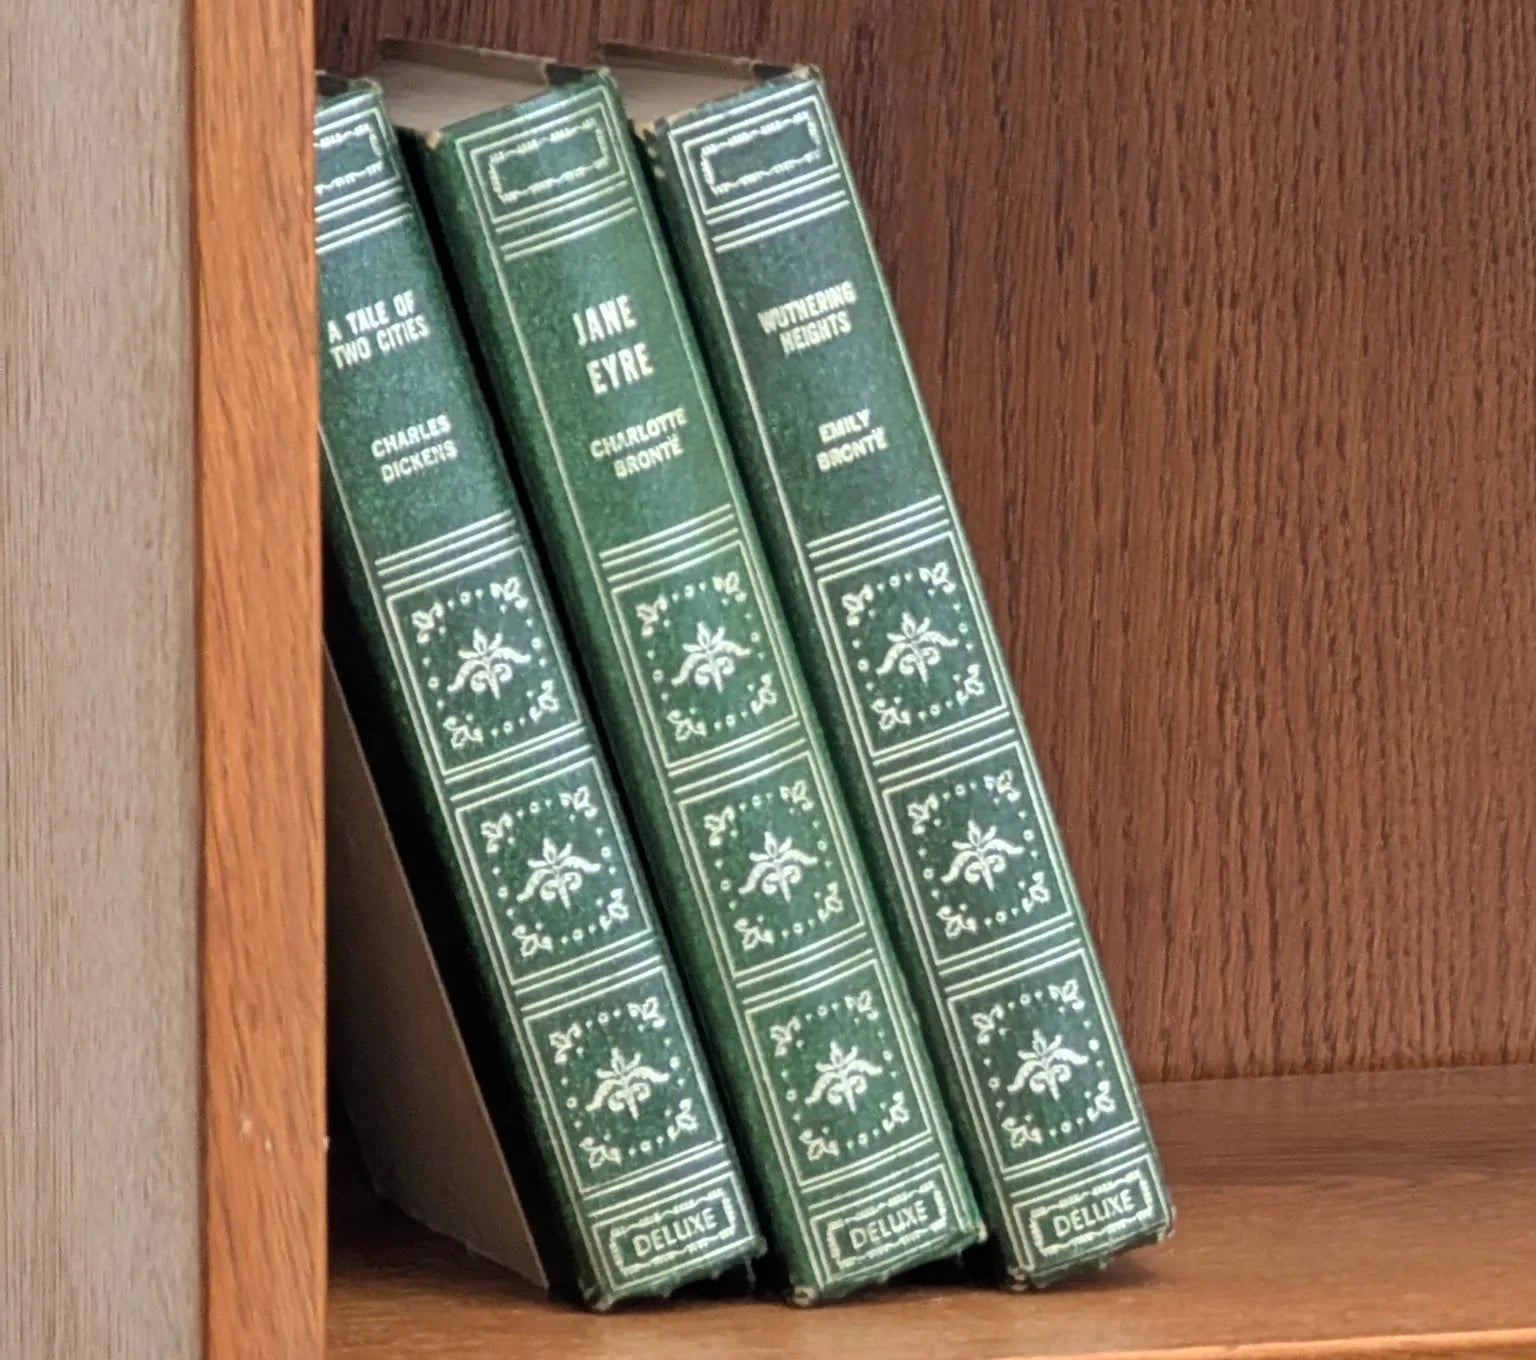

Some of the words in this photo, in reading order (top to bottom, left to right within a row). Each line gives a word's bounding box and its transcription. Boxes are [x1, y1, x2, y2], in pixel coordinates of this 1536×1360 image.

[327, 319, 343, 344] A
[345, 300, 390, 335] TALE
[392, 290, 416, 317] OF
[572, 294, 638, 347] JANE
[757, 280, 857, 335] WUTHERING
[779, 311, 852, 356] HEIGHTS
[329, 336, 372, 369] TWO
[376, 314, 430, 353] CITIES
[585, 342, 655, 395] EYRE
[371, 414, 451, 458] CHARLES
[589, 406, 688, 459] CHARLOTTE
[818, 408, 870, 443] EMILY
[380, 440, 459, 484] DICKENS
[632, 1210, 719, 1257] DELUXE
[848, 1197, 929, 1250] DELUXE
[1053, 1190, 1136, 1239] DELUXE
